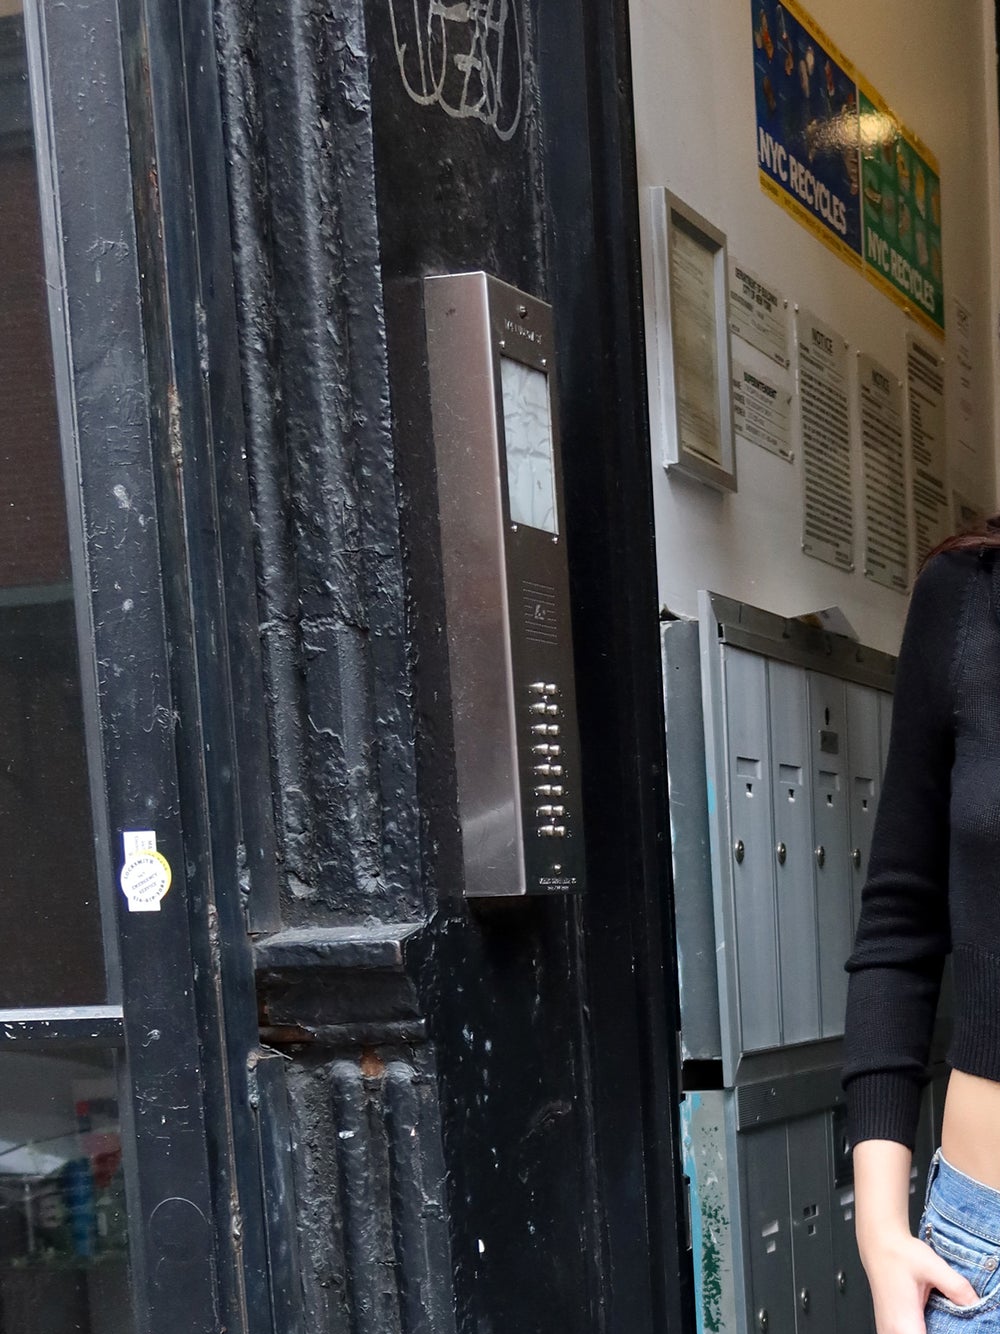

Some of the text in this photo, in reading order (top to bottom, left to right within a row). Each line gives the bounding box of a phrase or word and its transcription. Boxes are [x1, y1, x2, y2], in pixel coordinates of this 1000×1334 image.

[758, 127, 848, 235] NYC RECYCLES
[867, 227, 936, 313] NYC RECYCLES
